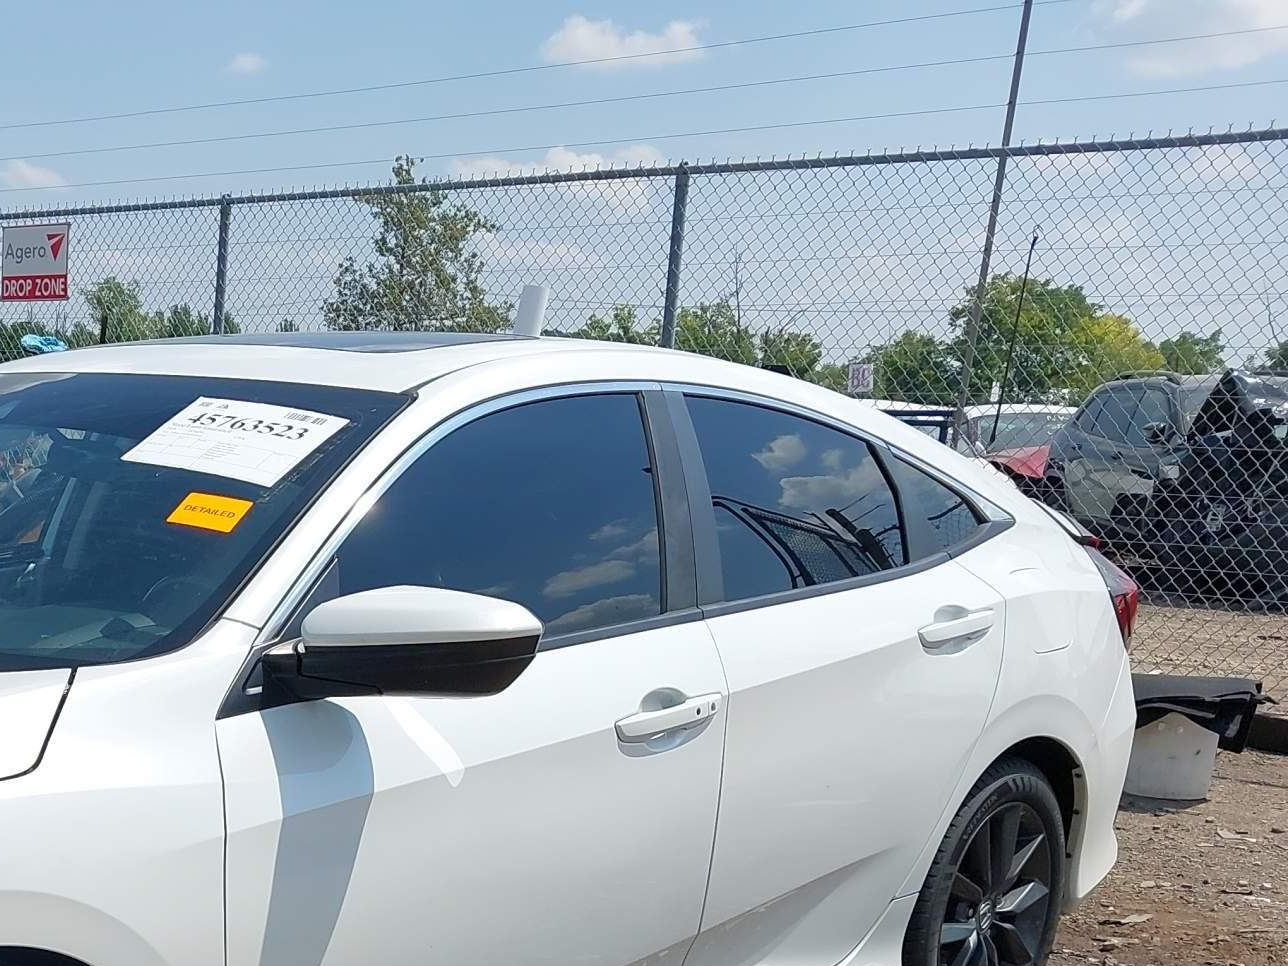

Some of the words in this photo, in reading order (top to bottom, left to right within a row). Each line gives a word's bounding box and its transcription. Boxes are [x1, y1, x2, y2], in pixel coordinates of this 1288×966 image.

[4, 243, 46, 264] Agero
[3, 279, 33, 297] DROP
[35, 277, 65, 296] ZONE
[187, 412, 310, 442] 45763523
[183, 504, 235, 519] DETAILED
